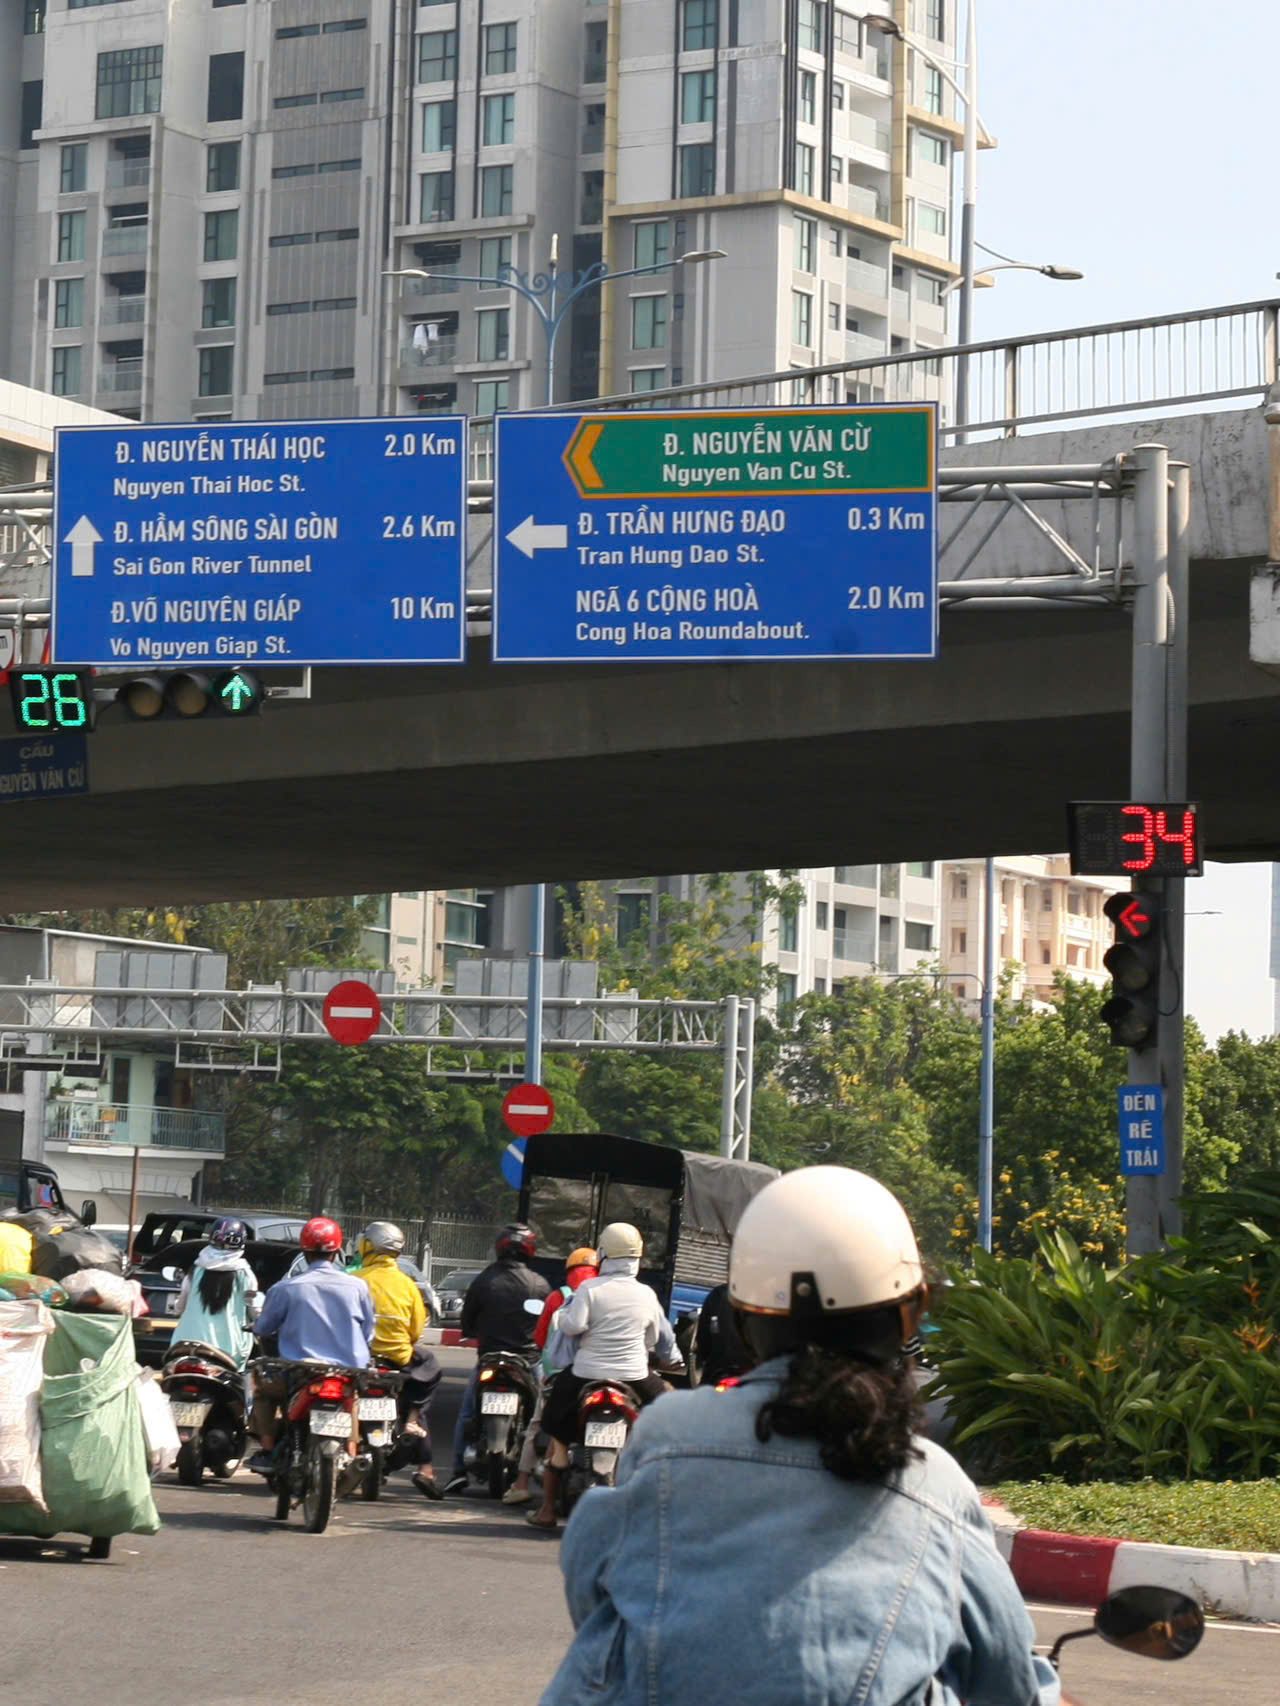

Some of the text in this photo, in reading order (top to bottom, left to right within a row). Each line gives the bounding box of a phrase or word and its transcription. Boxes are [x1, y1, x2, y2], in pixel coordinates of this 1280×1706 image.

[116, 432, 326, 465] Đ. NGUYỄN THÁI HỌC
[384, 433, 456, 457] 2.0 Km
[663, 422, 872, 456] Đ. NGUYỄN VĂN CỪ
[662, 460, 851, 487] Nguyen Van Cu St.
[114, 474, 306, 501] Nguyen Thai Hoc St.
[114, 511, 338, 543] Đ. HẦM SÔNG SÀI GÒN
[383, 515, 456, 539] 2.6 Km
[577, 504, 786, 537] Đ. TRẦN HƯNG ĐẠO
[848, 506, 925, 531] 0.3 Km
[113, 555, 312, 576] Sai Gon River Tunnel
[577, 543, 765, 568] Tran Hung Dao St.
[164, 595, 247, 623] NGUYÊN
[254, 593, 301, 621] GIÁP
[391, 596, 455, 620] 10 Km
[576, 582, 759, 615] NGÃ 6 CỘNG HOÀ
[848, 586, 925, 611] 2.0 Km
[576, 621, 810, 646] Cong Hoa Roundabout.
[110, 635, 291, 660] Vo Nguyen Giap St.
[21, 674, 86, 726] 26
[1122, 805, 1195, 871] 34
[1125, 1146, 1159, 1167] TRÁI
